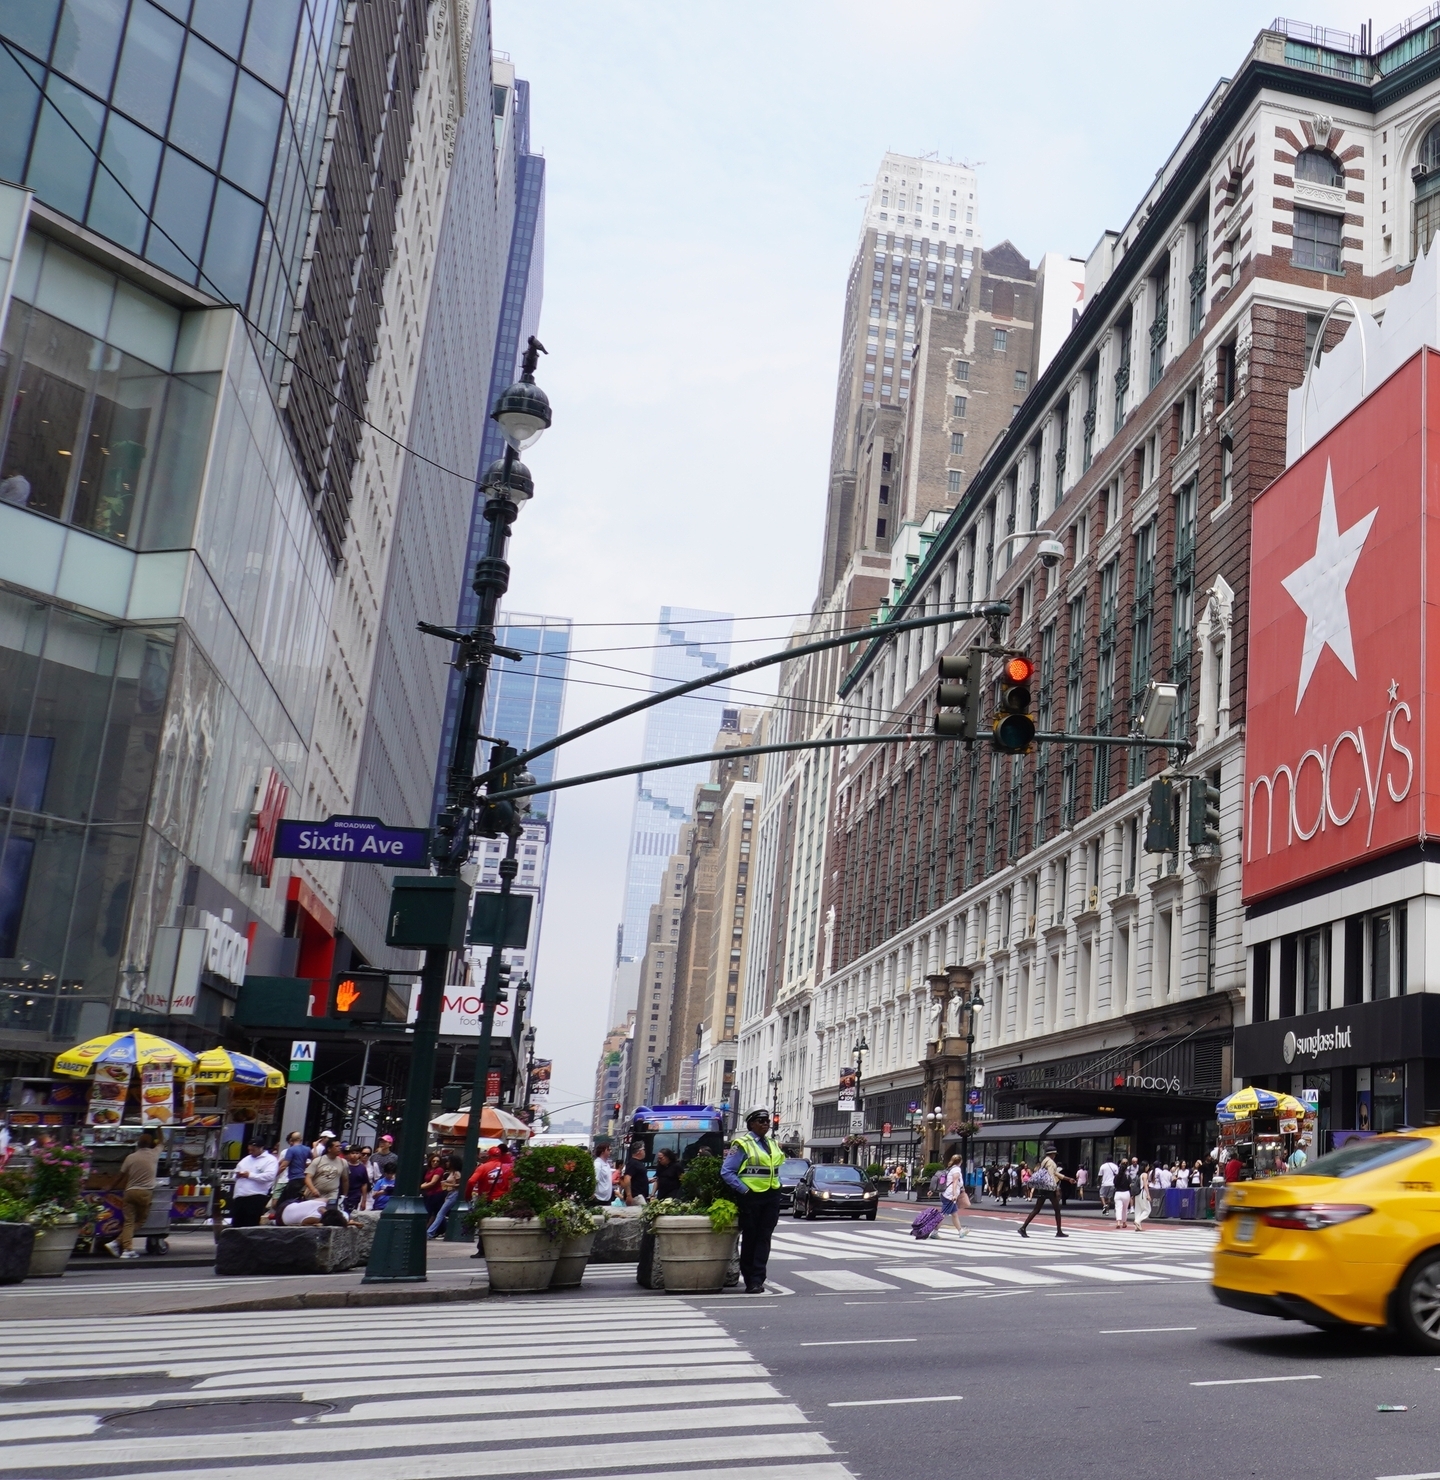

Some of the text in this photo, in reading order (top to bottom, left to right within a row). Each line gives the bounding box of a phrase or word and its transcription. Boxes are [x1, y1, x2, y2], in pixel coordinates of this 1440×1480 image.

[1247, 680, 1414, 863] macy's
[334, 821, 376, 830] BROADWAY
[298, 831, 404, 855] Sixth Ave
[1296, 1025, 1352, 1059] sunglass hut
[56, 1061, 88, 1072] SABRETT
[1127, 1075, 1181, 1093] macy's
